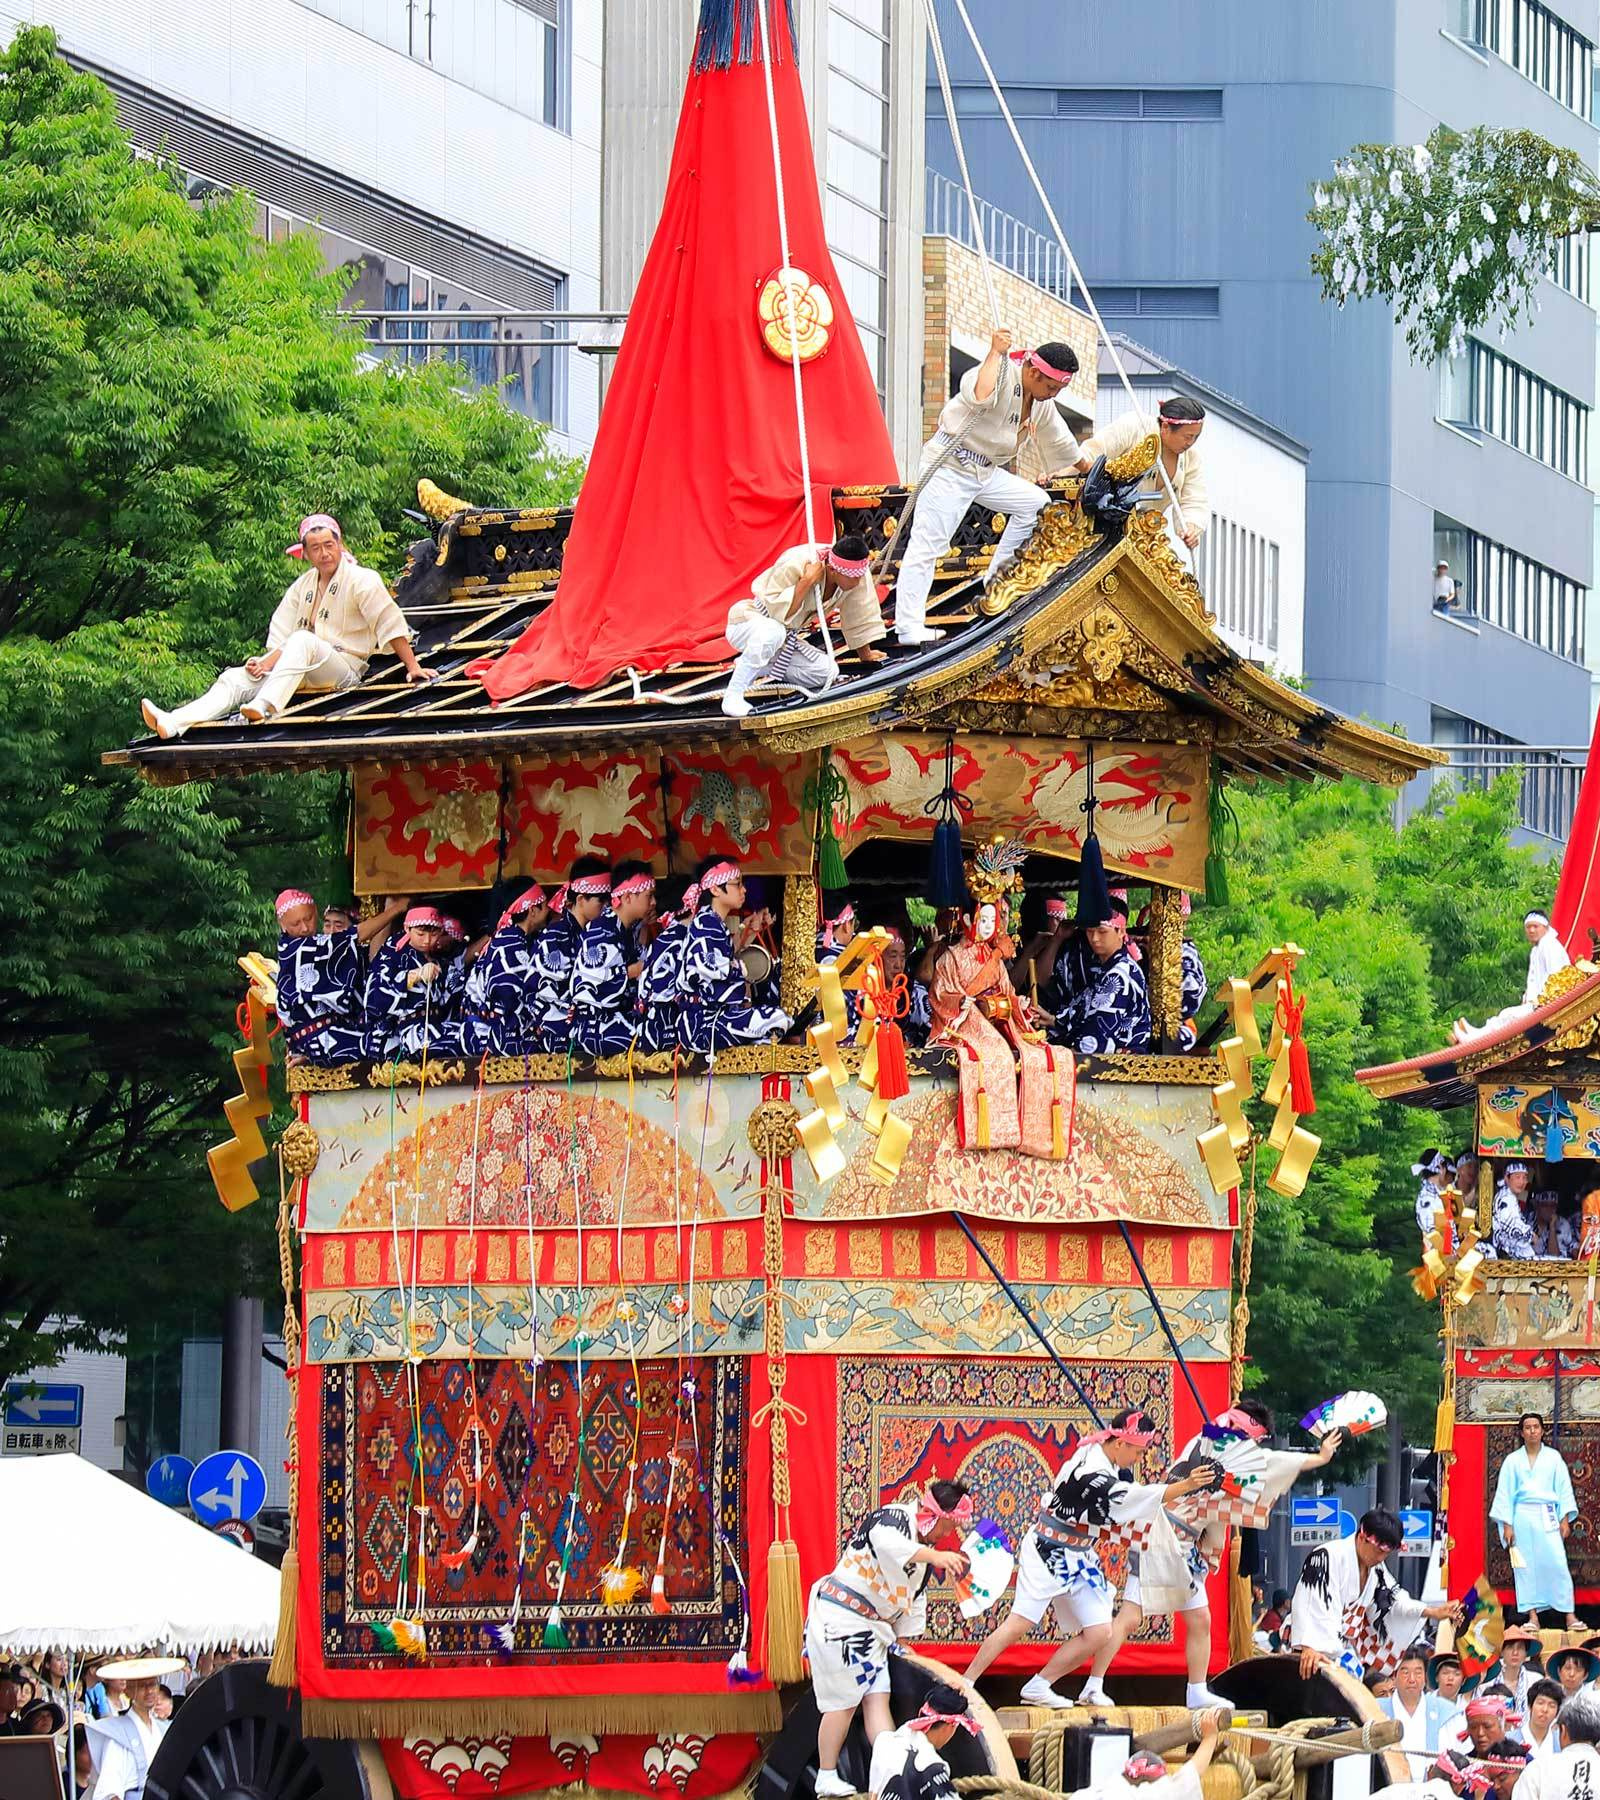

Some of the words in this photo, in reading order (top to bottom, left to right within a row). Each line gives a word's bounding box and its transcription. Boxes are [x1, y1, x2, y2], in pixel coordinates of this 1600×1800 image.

[6, 1433, 76, 1450] 自転車を除く
